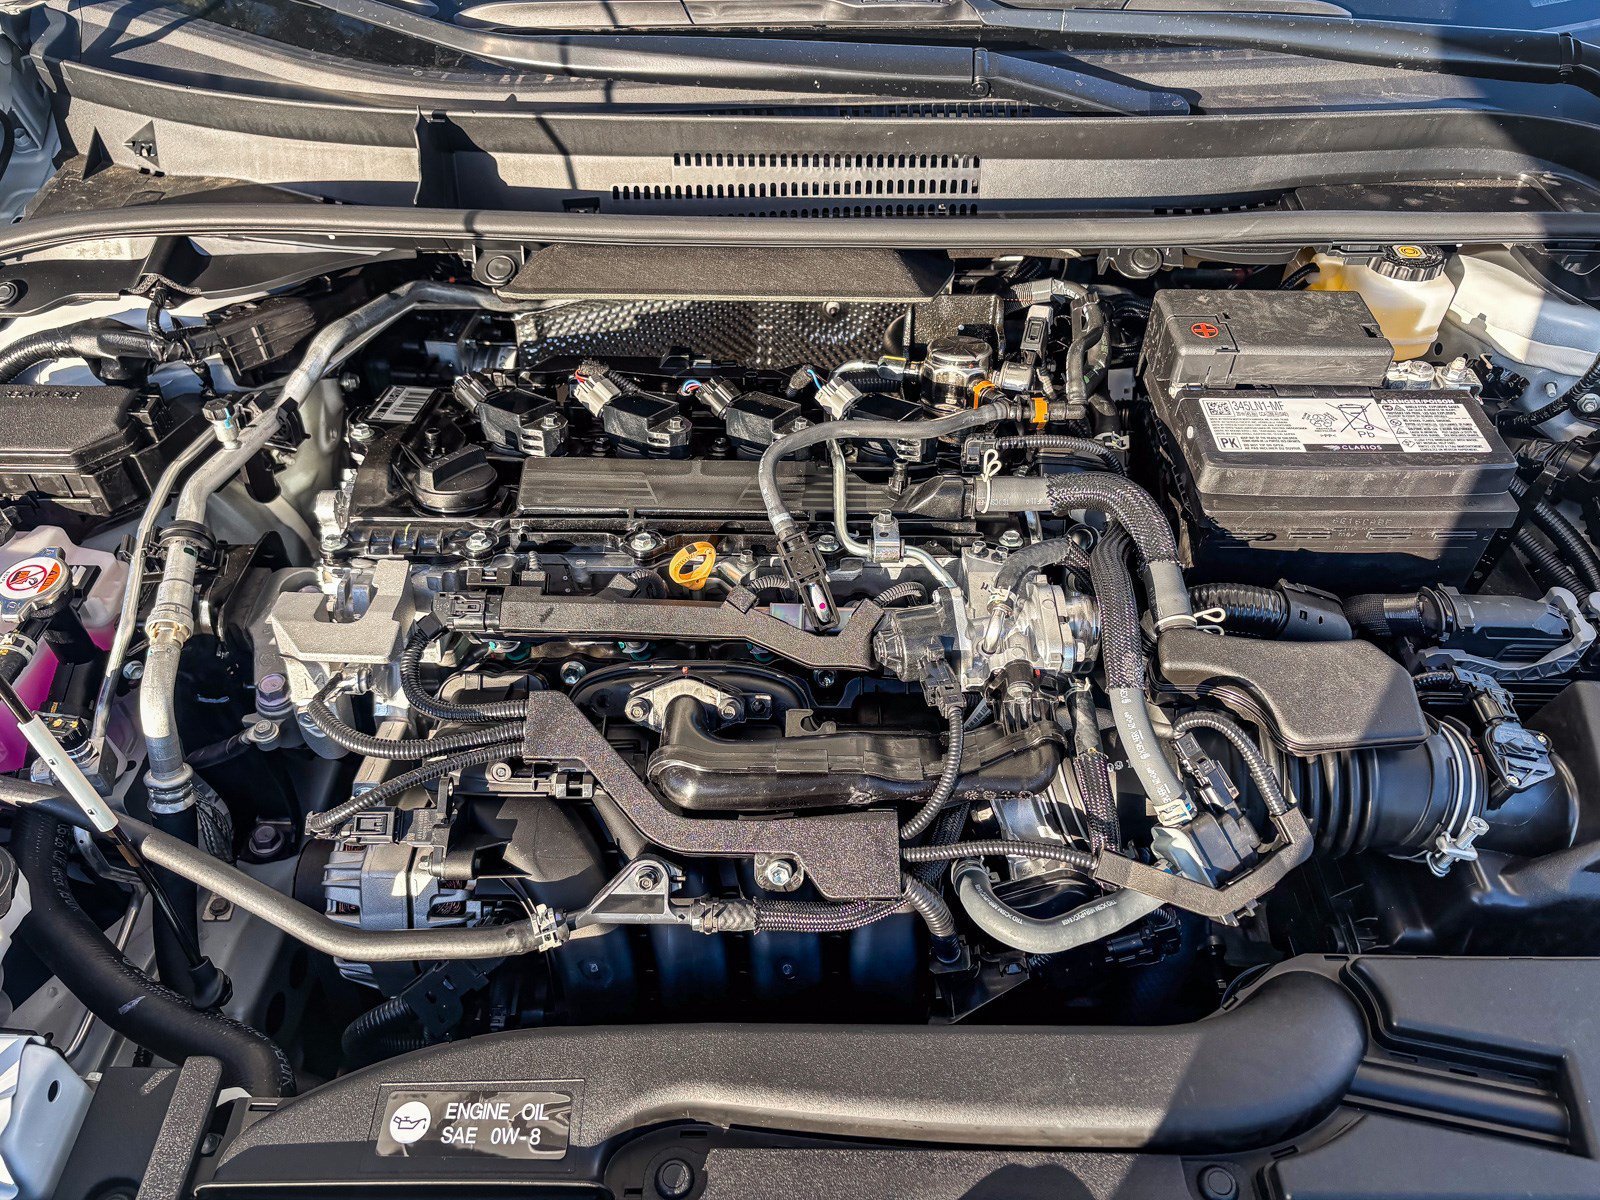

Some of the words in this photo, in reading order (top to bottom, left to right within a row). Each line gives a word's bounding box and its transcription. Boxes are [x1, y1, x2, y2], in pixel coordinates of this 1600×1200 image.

[1231, 400, 1284, 411] 345LN1-MF
[1357, 430, 1376, 439] Pb
[1220, 437, 1240, 449] PK
[444, 1102, 511, 1121] ENGINE
[521, 1102, 550, 1121] OIL
[440, 1126, 478, 1145] SAE
[490, 1127, 542, 1146] 0W-8
